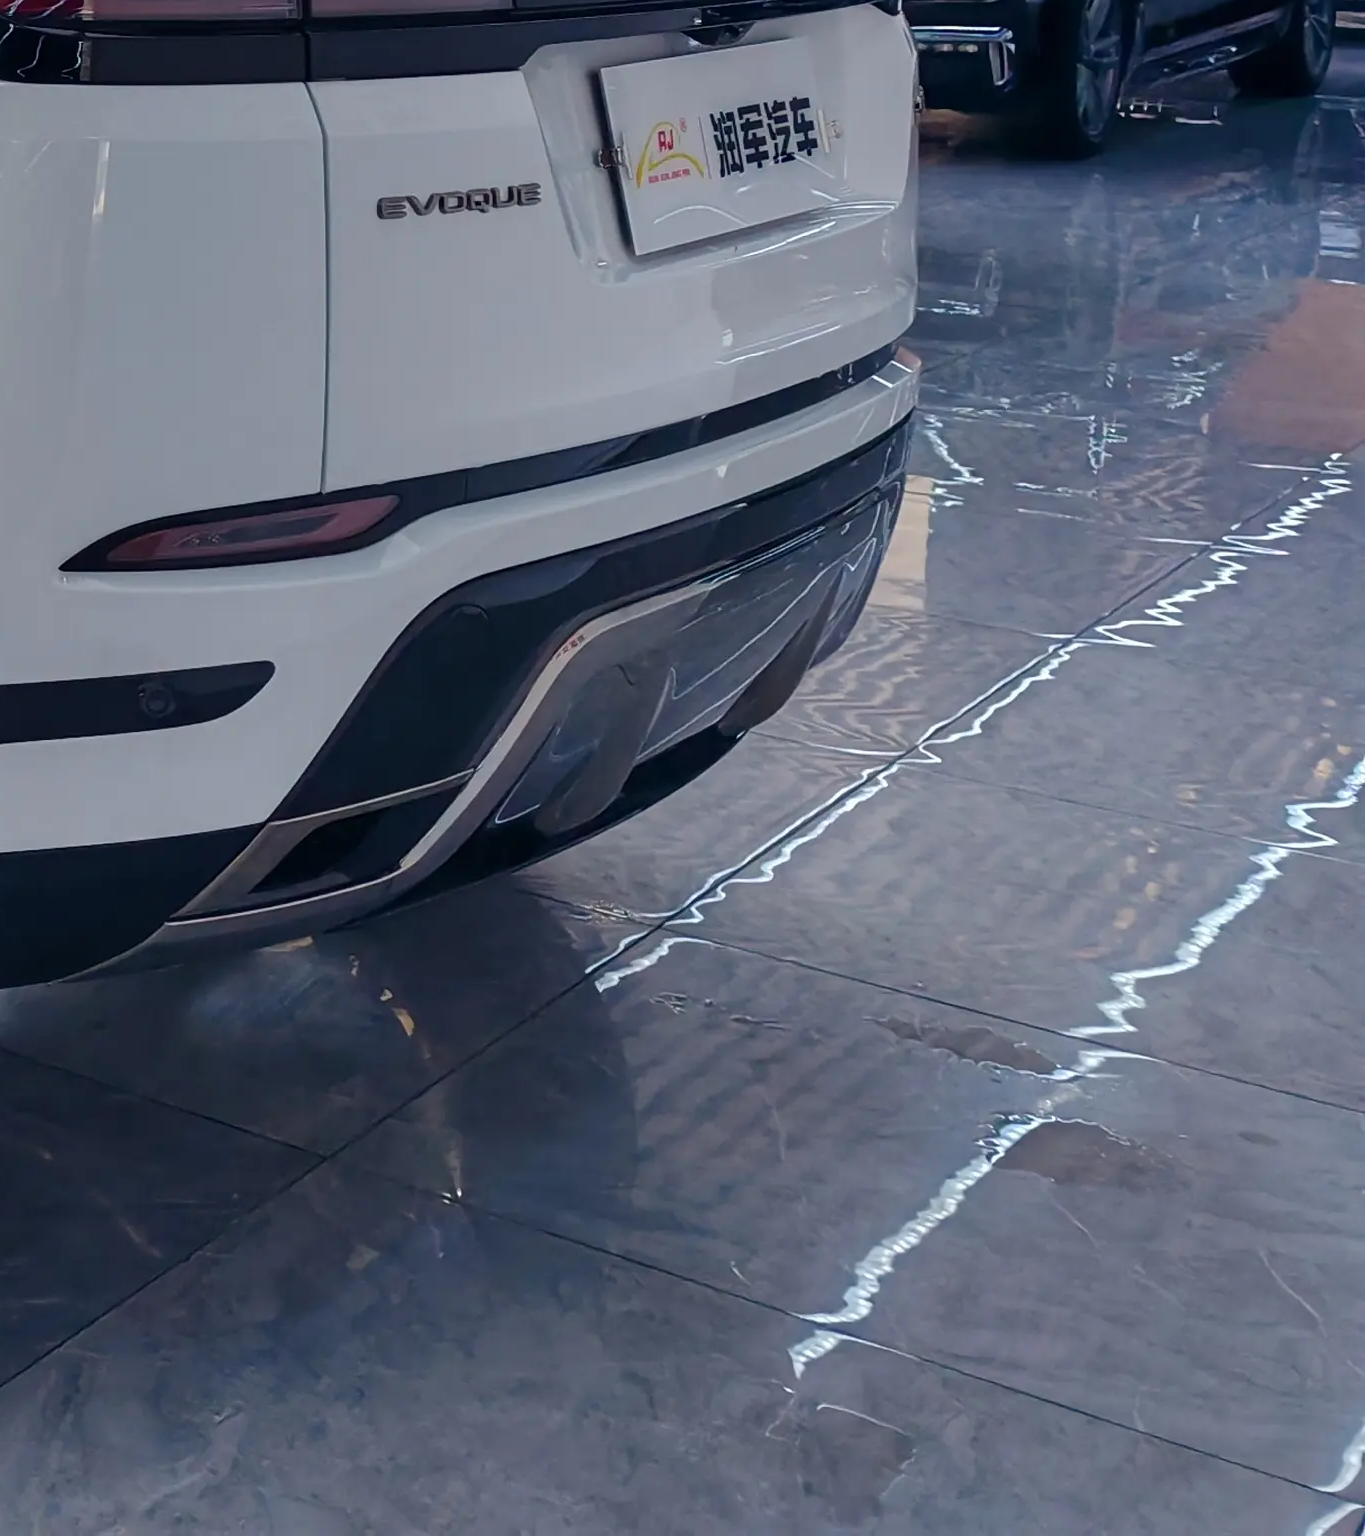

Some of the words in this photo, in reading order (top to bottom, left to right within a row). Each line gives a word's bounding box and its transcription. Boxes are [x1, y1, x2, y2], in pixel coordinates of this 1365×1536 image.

[708, 95, 818, 179] 润军汽车
[376, 182, 542, 220] EVOQUE
